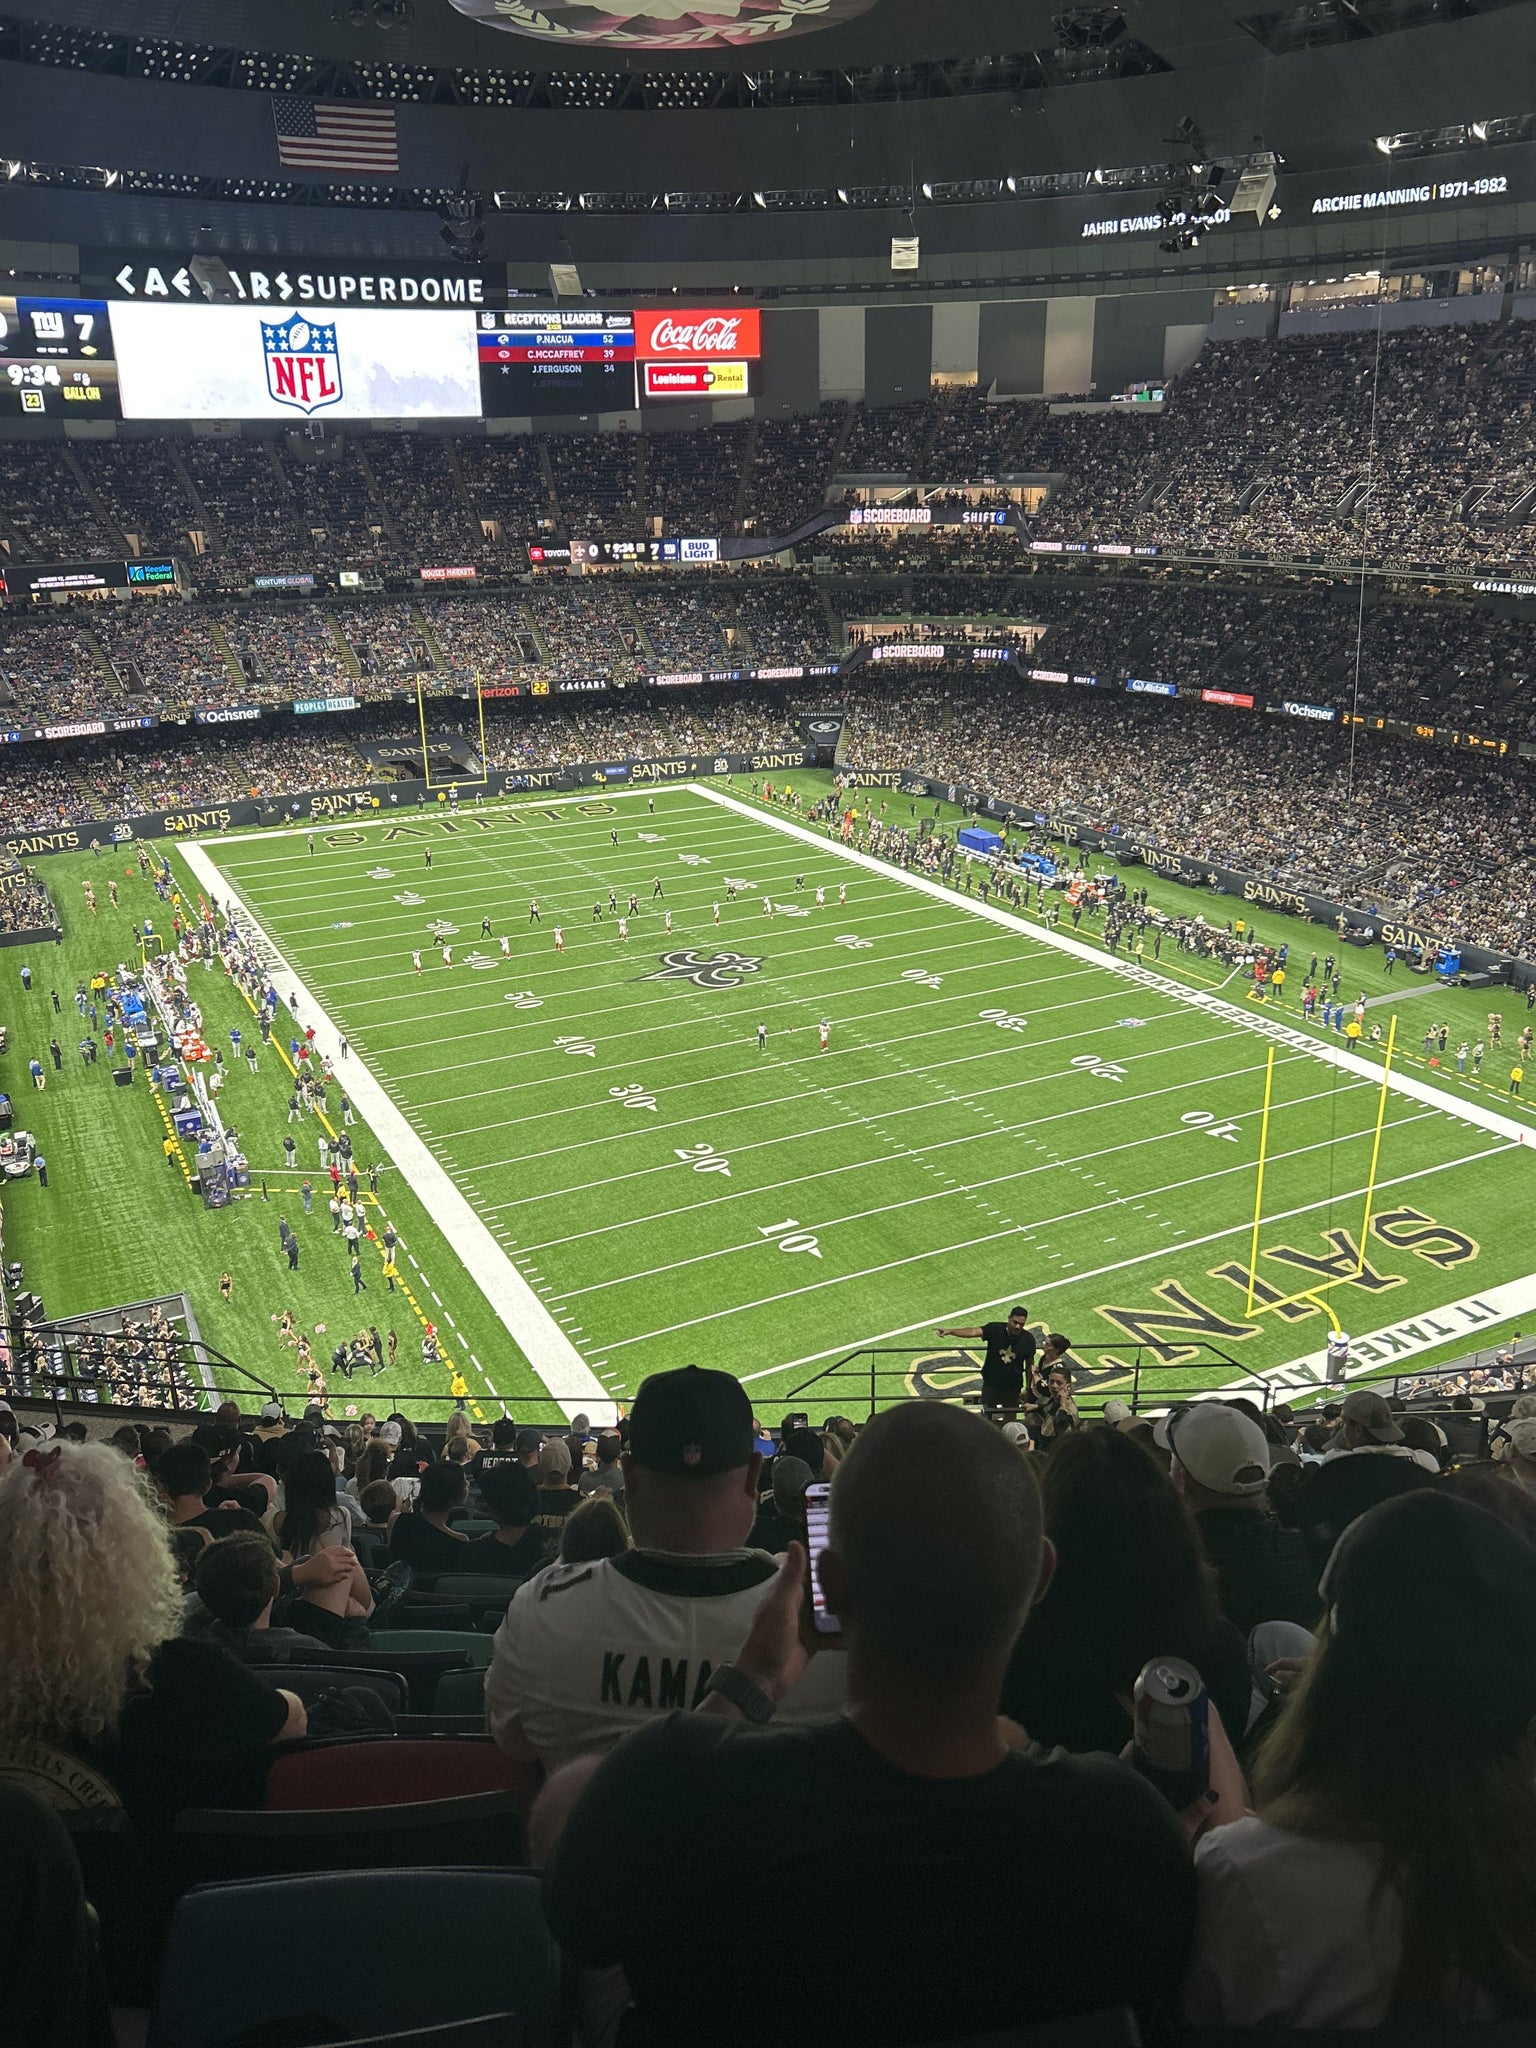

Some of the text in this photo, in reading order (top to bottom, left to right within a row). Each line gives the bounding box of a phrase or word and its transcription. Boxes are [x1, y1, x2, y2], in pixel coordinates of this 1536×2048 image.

[1313, 176, 1507, 214] ARCHIE MANNING 1971-1982
[1082, 219, 1118, 238] JAHRI
[1120, 215, 1162, 232] EVANS
[116, 264, 485, 303] CAERS SUPERDOME
[73, 314, 94, 341] 7
[504, 313, 561, 326] RECEPTIONS
[561, 313, 604, 326] LEADERS
[536, 334, 614, 344] P.NACUA 52
[650, 317, 742, 352] Coca-Cola
[527, 349, 615, 359] C.MCCAFFREY 39
[7, 364, 60, 386] 9:34
[532, 364, 615, 374] J.FERGUSON 34
[271, 356, 336, 404] NFL
[717, 374, 743, 382] Rental
[863, 508, 931, 524] SCOREBOARD
[543, 549, 571, 558] TOYOTA
[684, 549, 714, 559] LIGHT
[687, 541, 710, 551] BUD
[145, 571, 173, 581] Federal
[255, 575, 314, 587] VENTURE GLOBAL
[882, 645, 944, 658] SCOREBOARD
[656, 673, 702, 685] SCOREBOARD
[757, 667, 803, 679] SCOREBOARD
[478, 686, 520, 699] verizon
[533, 682, 548, 694] 22
[559, 679, 606, 692] CAESARS
[295, 697, 354, 713] PEOPLES HEALTH
[1289, 703, 1334, 720] Ochsner
[160, 711, 191, 722] SAINTS
[206, 707, 260, 723] Ochsner
[44, 722, 105, 739] SCOREBOARD
[378, 743, 451, 757] SAINTS
[633, 761, 687, 778] SAINTS
[753, 753, 803, 769] SAINTS
[311, 791, 373, 811] SAINTS
[164, 809, 230, 832] SAINTS
[322, 803, 617, 849] SAINTS
[6, 831, 79, 855] SAINTS
[1244, 880, 1305, 913] SAINTS
[900, 969, 944, 989] 40
[504, 990, 544, 1009] 50
[1113, 963, 1331, 1051] INTERCEPT CANCER
[978, 1008, 1029, 1030] 30
[552, 1035, 596, 1056] 40
[1070, 1055, 1128, 1078] 20
[608, 1083, 657, 1109] 30
[1180, 1111, 1242, 1141] 10
[674, 1143, 730, 1174] 20
[757, 1217, 819, 1254] 10
[1455, 1300, 1501, 1324] IT
